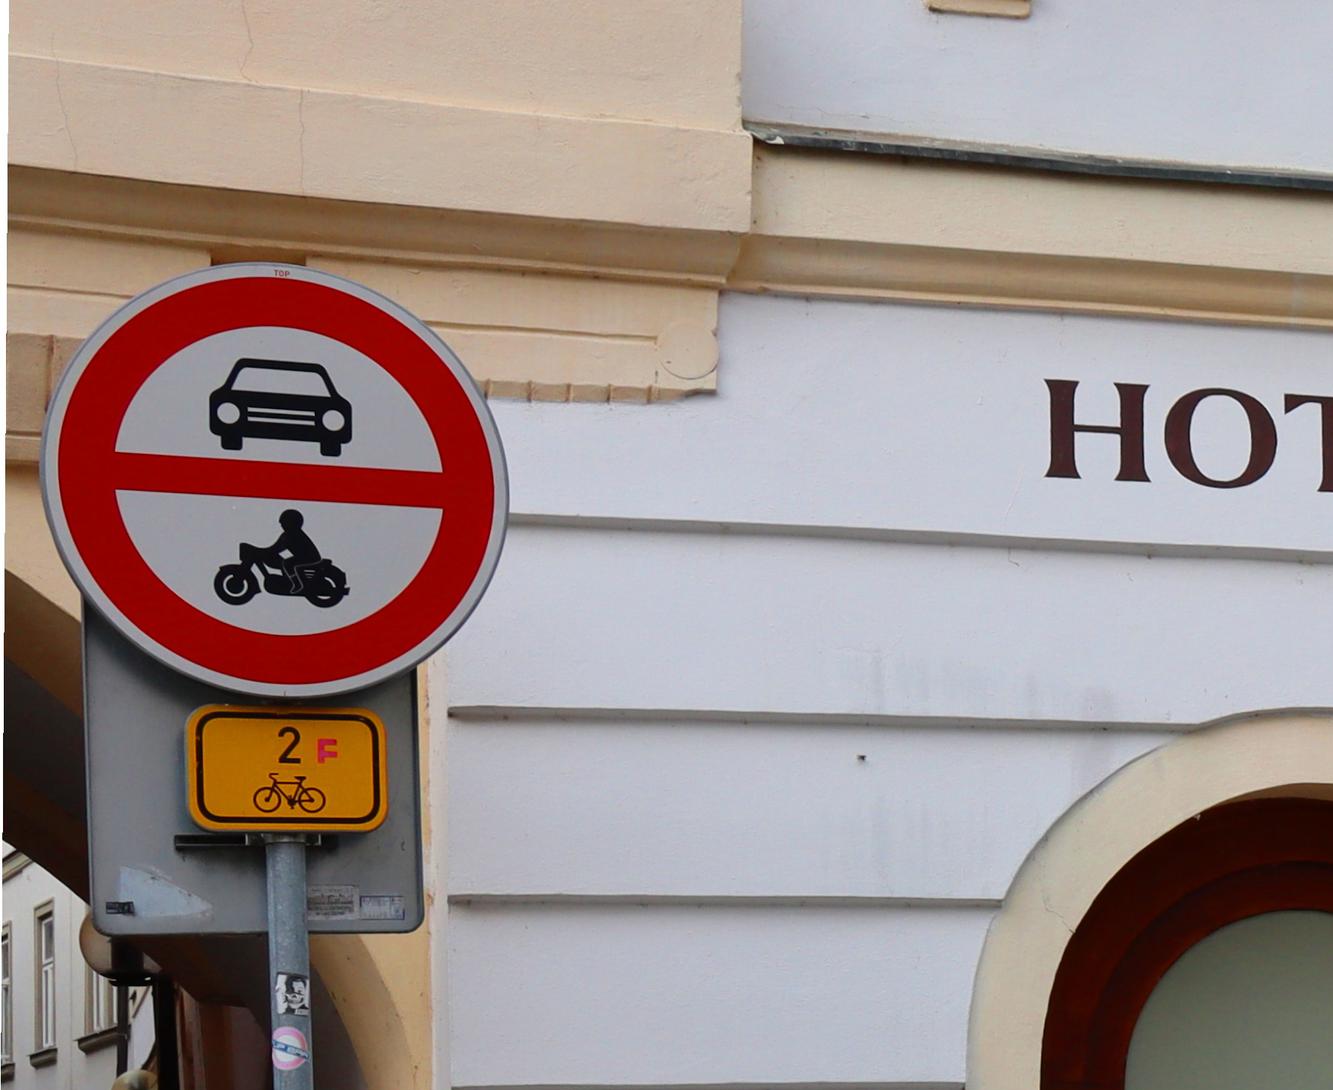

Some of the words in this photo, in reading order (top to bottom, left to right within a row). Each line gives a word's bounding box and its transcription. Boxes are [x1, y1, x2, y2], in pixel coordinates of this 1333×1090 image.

[274, 269, 290, 278] TOP
[278, 726, 302, 764] 2
[317, 738, 338, 764] F
